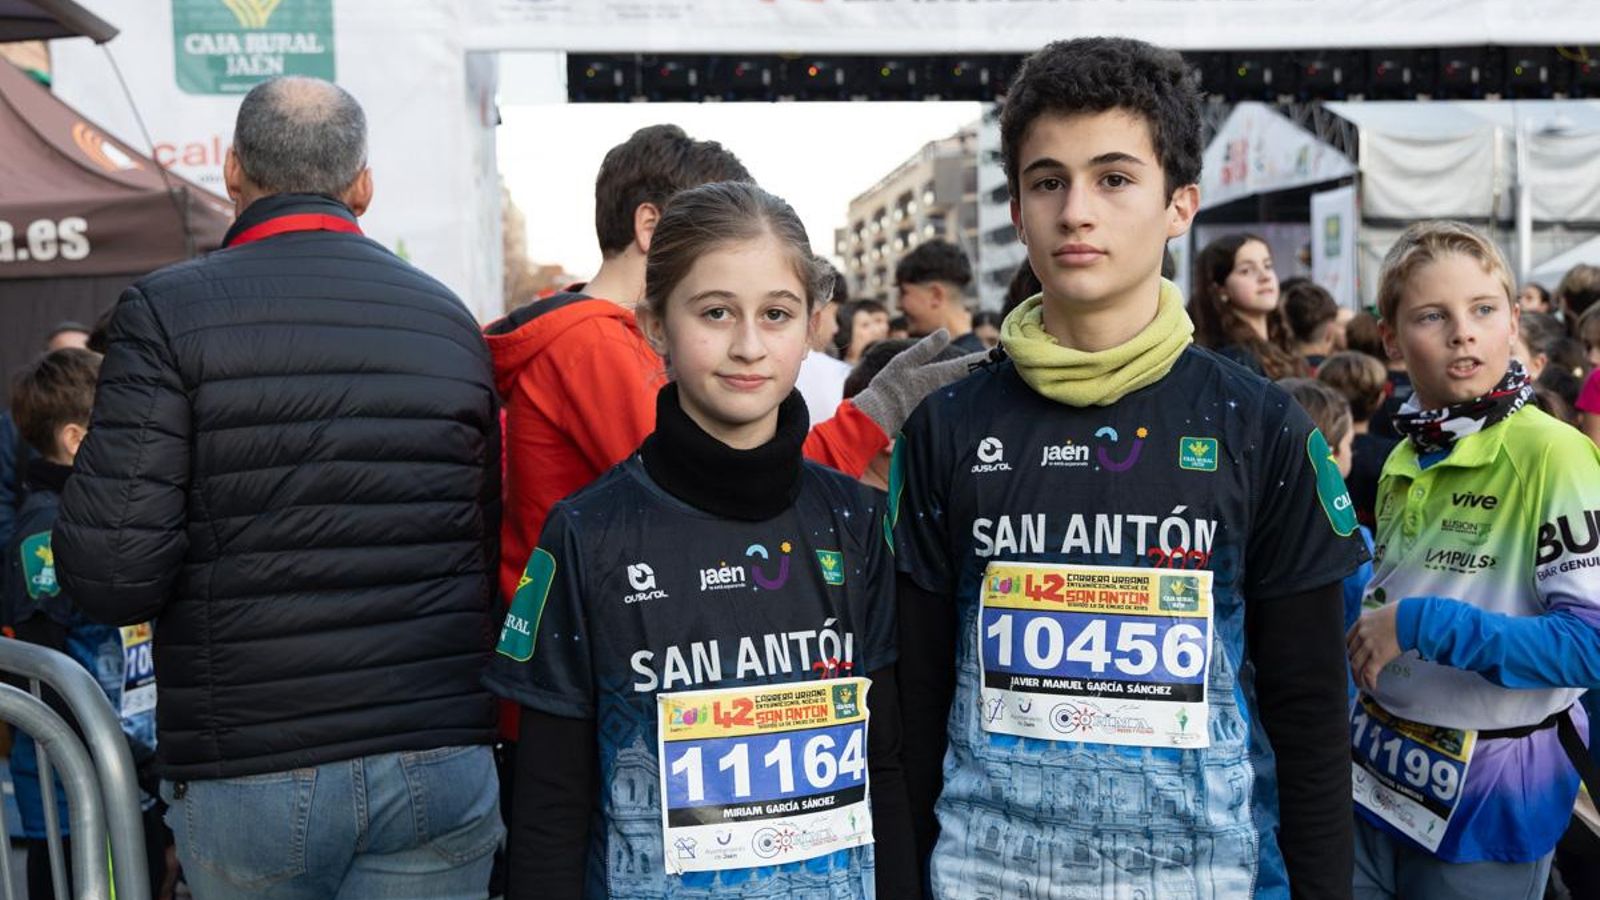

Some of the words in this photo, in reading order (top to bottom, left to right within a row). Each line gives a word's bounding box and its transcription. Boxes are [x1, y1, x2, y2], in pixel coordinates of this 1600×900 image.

[184, 33, 241, 55] CAJA
[245, 32, 325, 53] RURAL
[153, 135, 221, 168] cal
[971, 462, 1013, 473] austral
[1452, 491, 1498, 510] vive
[973, 513, 1046, 557] SAN
[1061, 506, 1218, 557] ANTÓN
[1535, 510, 1600, 566] BU
[1067, 573, 1110, 583] CARRERA
[1112, 576, 1150, 585] URBANA
[1537, 566, 1558, 582] BAR
[624, 590, 669, 604] austral
[1025, 574, 1065, 603] 42
[1066, 590, 1096, 603] SAN
[988, 614, 1205, 678] 10456
[631, 642, 722, 692] SAN
[755, 691, 793, 704] CARRERA
[795, 689, 826, 699] URBANA
[1011, 676, 1040, 688] JAVIER
[1043, 679, 1083, 691] MANUEL
[1086, 680, 1123, 693] GARCÍA
[1127, 682, 1172, 695] SÁNCHEZ
[713, 697, 755, 729] 42
[755, 709, 783, 724] SAN
[672, 728, 865, 801] 11164
[1352, 713, 1459, 801] 11199
[723, 805, 762, 818] MIRIAM
[766, 801, 799, 814] GARCÍA
[802, 795, 835, 810] SÁNCHEZ
